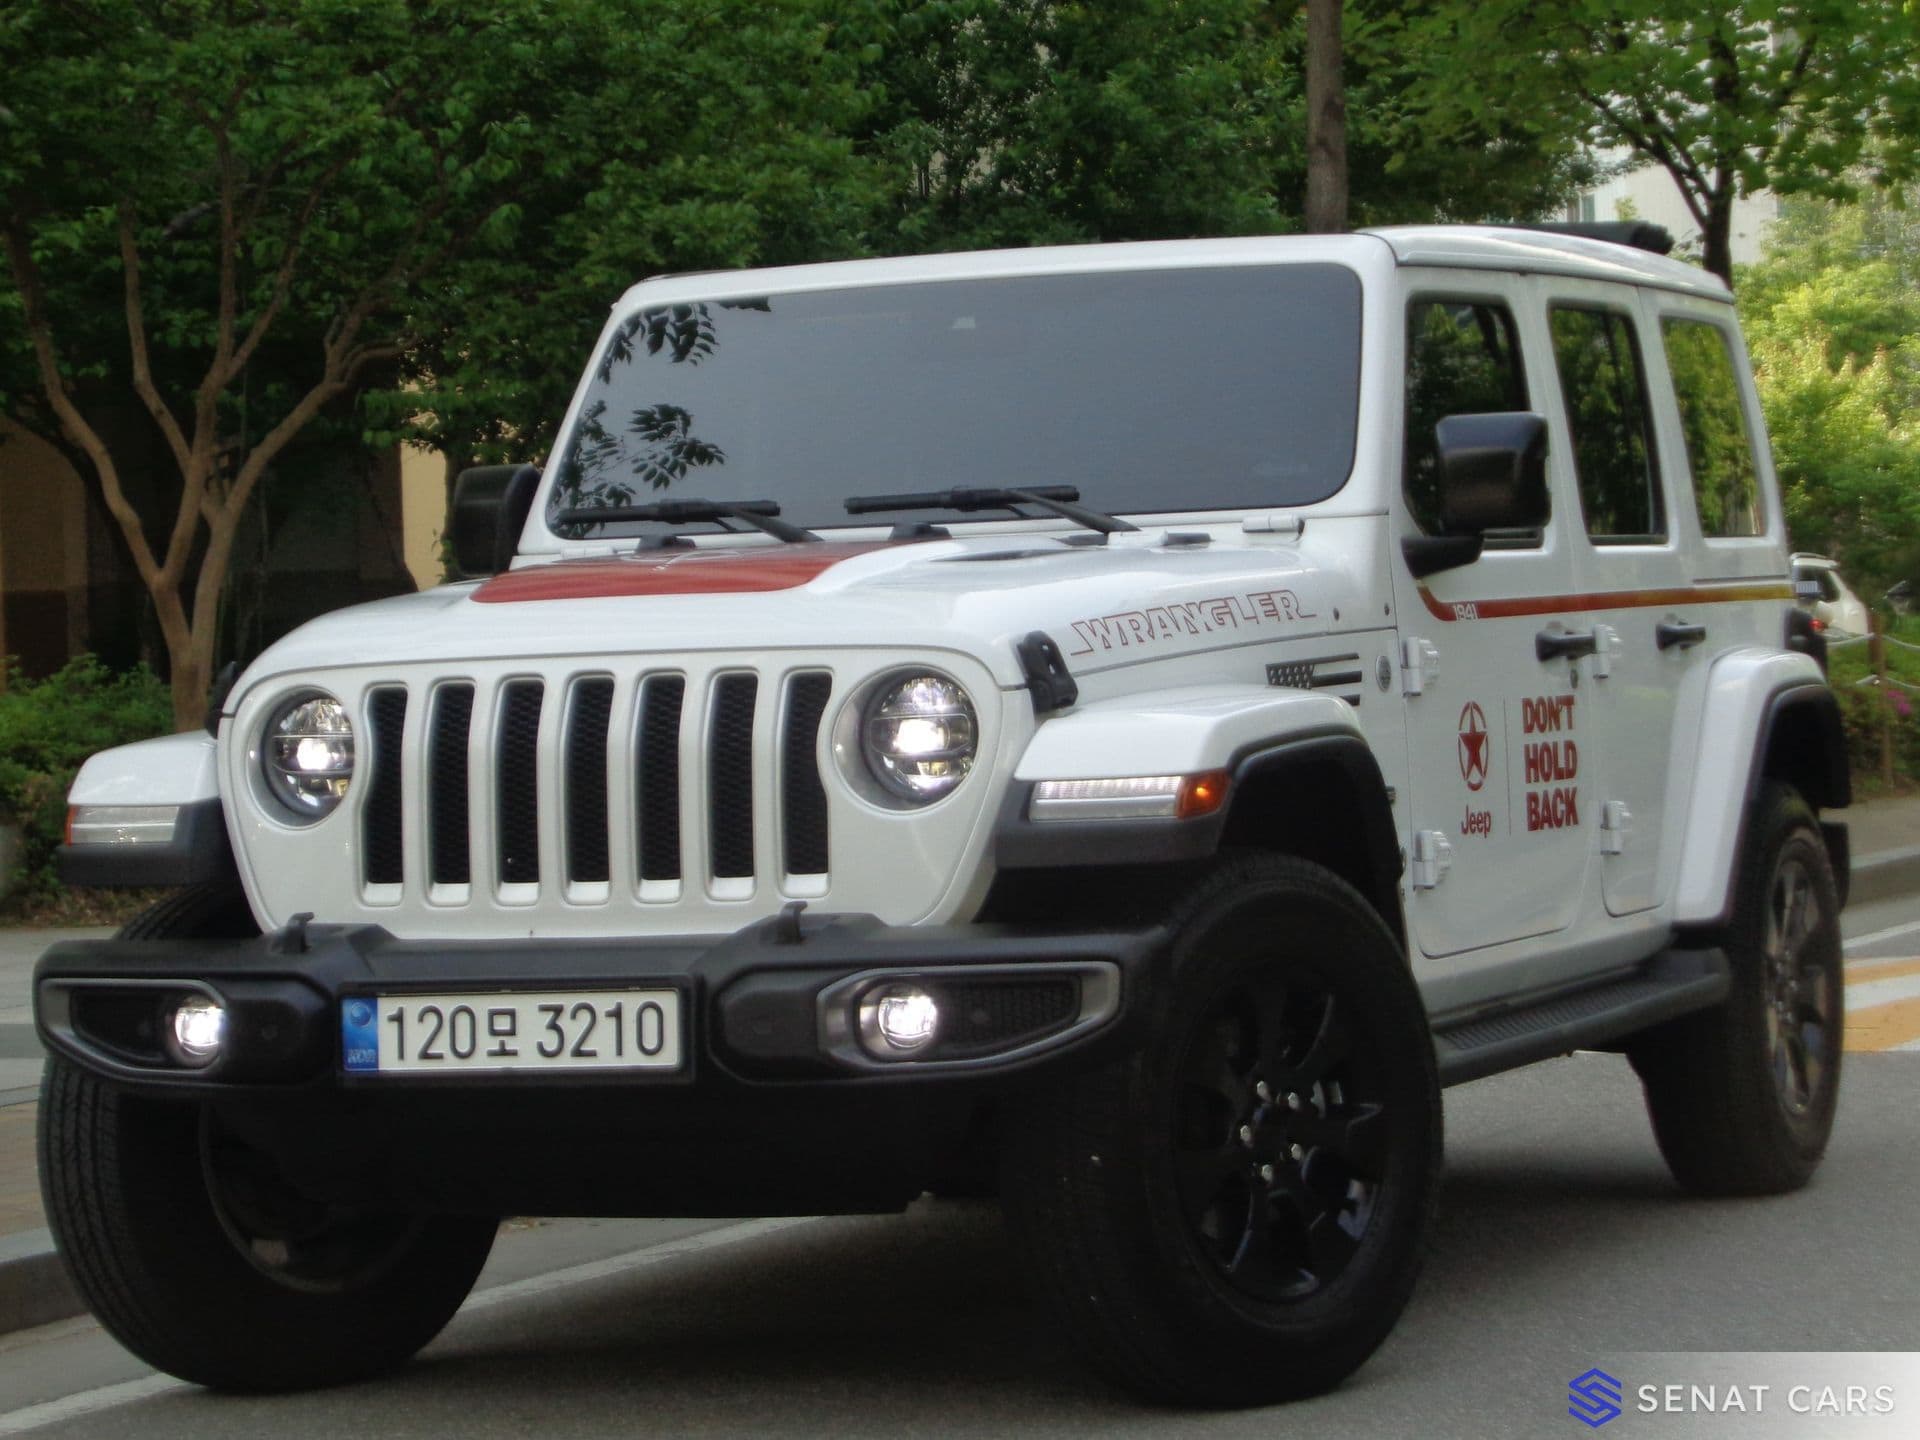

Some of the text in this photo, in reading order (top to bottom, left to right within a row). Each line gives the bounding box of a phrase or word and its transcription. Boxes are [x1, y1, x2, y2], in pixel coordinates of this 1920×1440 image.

[1071, 589, 1317, 655] WRANGLER
[1453, 603, 1479, 620] 1941
[1522, 696, 1575, 733] DON'T
[1524, 741, 1577, 783] HOLD
[1461, 805, 1491, 838] Jeep
[1527, 787, 1579, 831] BACK
[536, 1001, 664, 1058] 3210
